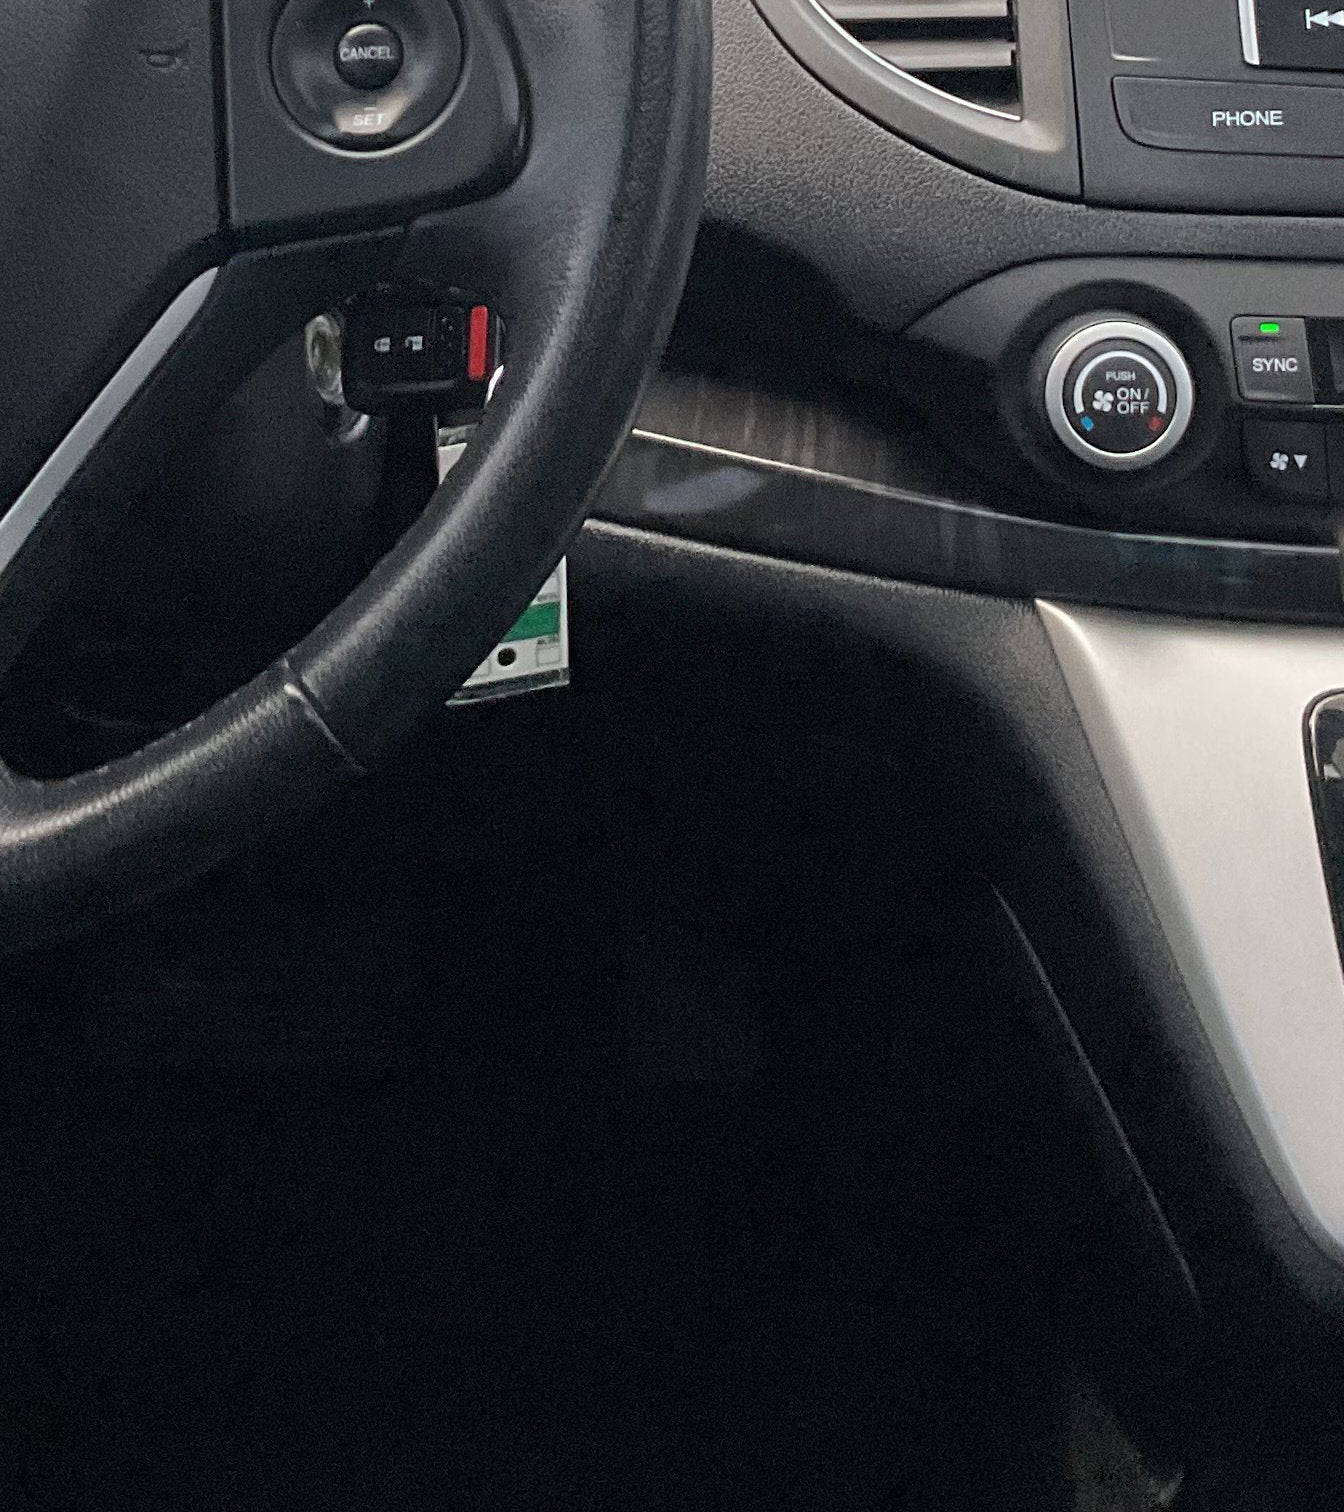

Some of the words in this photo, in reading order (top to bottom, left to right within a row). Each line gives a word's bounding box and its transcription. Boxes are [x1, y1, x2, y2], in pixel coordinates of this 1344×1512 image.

[339, 45, 394, 61] CANCEL
[353, 113, 386, 127] SET
[1211, 109, 1285, 127] PHONE
[1252, 356, 1298, 373] SYNC
[1105, 370, 1136, 382] PUSH
[1116, 402, 1150, 416] OFF
